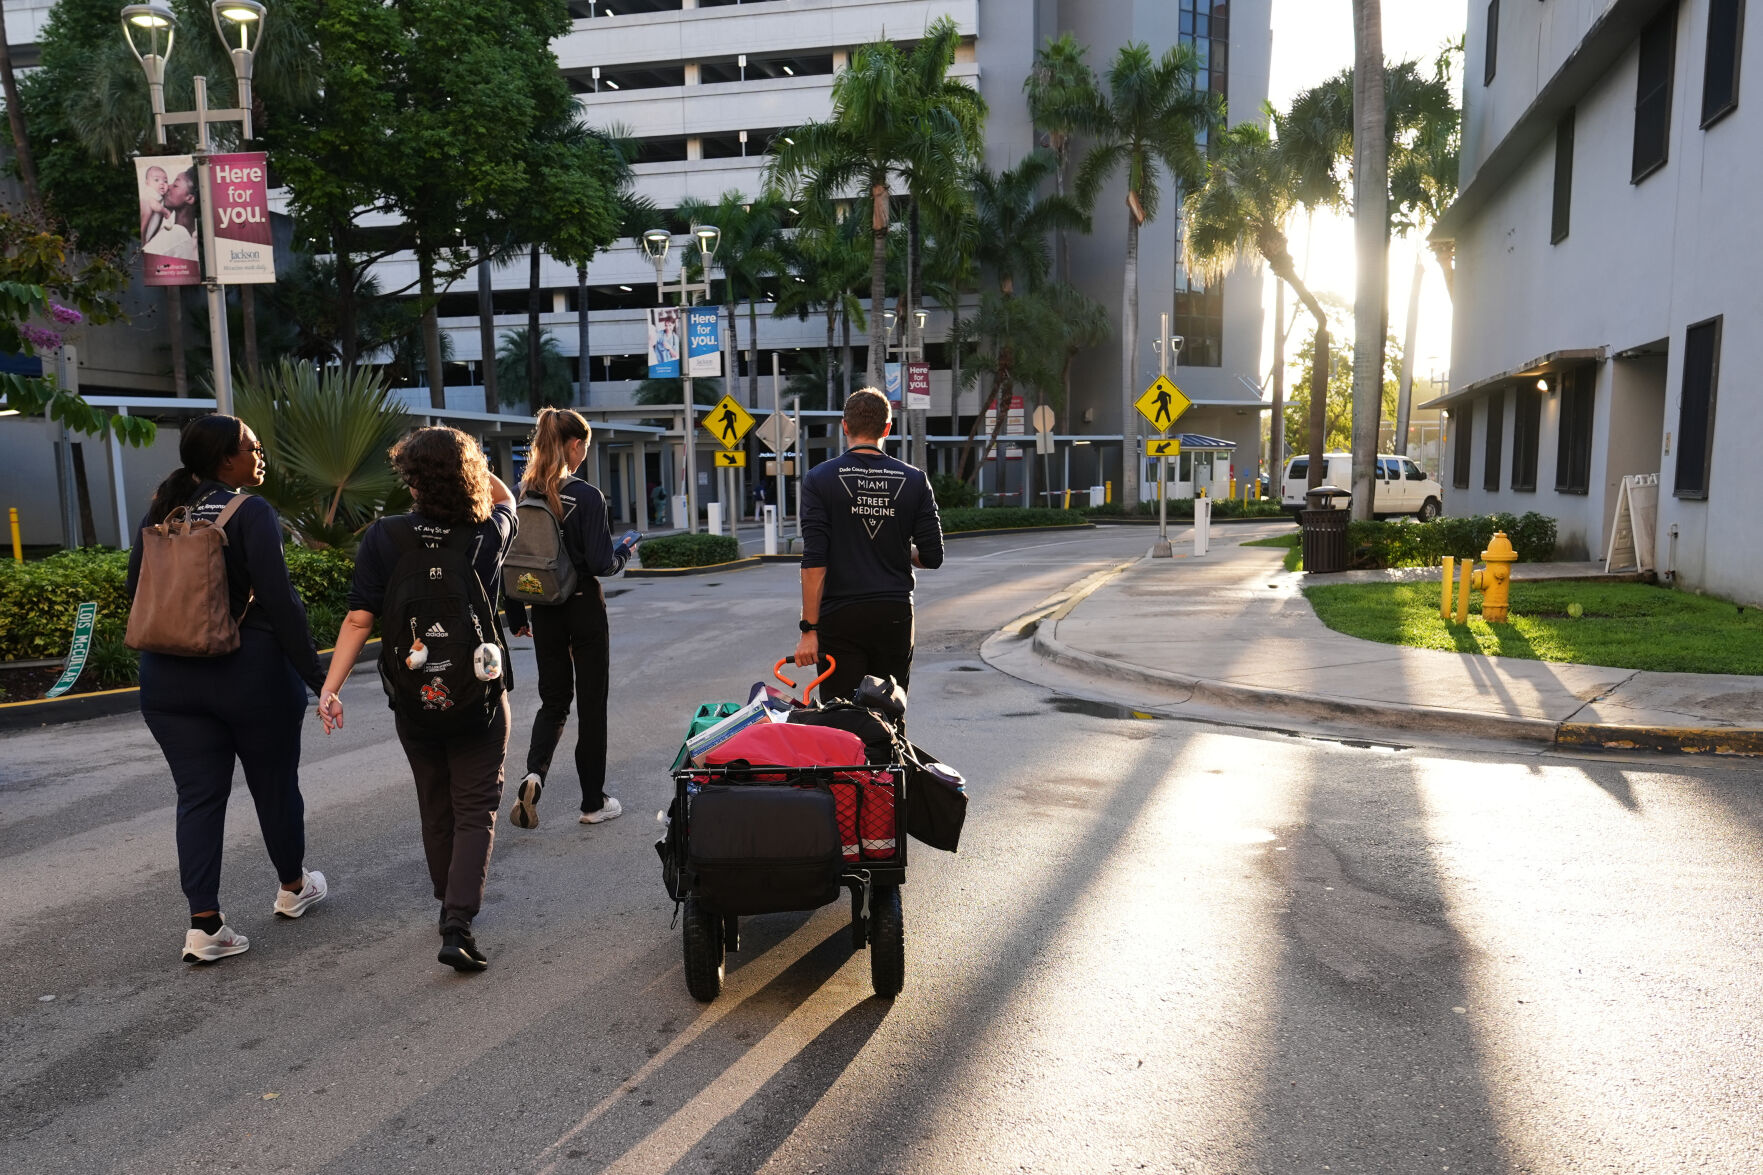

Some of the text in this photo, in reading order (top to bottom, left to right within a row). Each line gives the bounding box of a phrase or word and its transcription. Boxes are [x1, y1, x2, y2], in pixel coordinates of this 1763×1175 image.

[215, 165, 262, 184] Here
[228, 186, 253, 203] for
[218, 206, 266, 229] you.
[230, 249, 260, 260] Jackson
[690, 313, 717, 324] Here
[697, 325, 711, 335] for
[691, 335, 718, 348] you.
[909, 381, 928, 390] you.
[851, 466, 868, 475] County
[883, 468, 905, 476] Response
[857, 479, 888, 490] MIAMI
[856, 496, 890, 507] STREET
[851, 506, 895, 517] MEDICINE
[77, 607, 94, 629] LOIS
